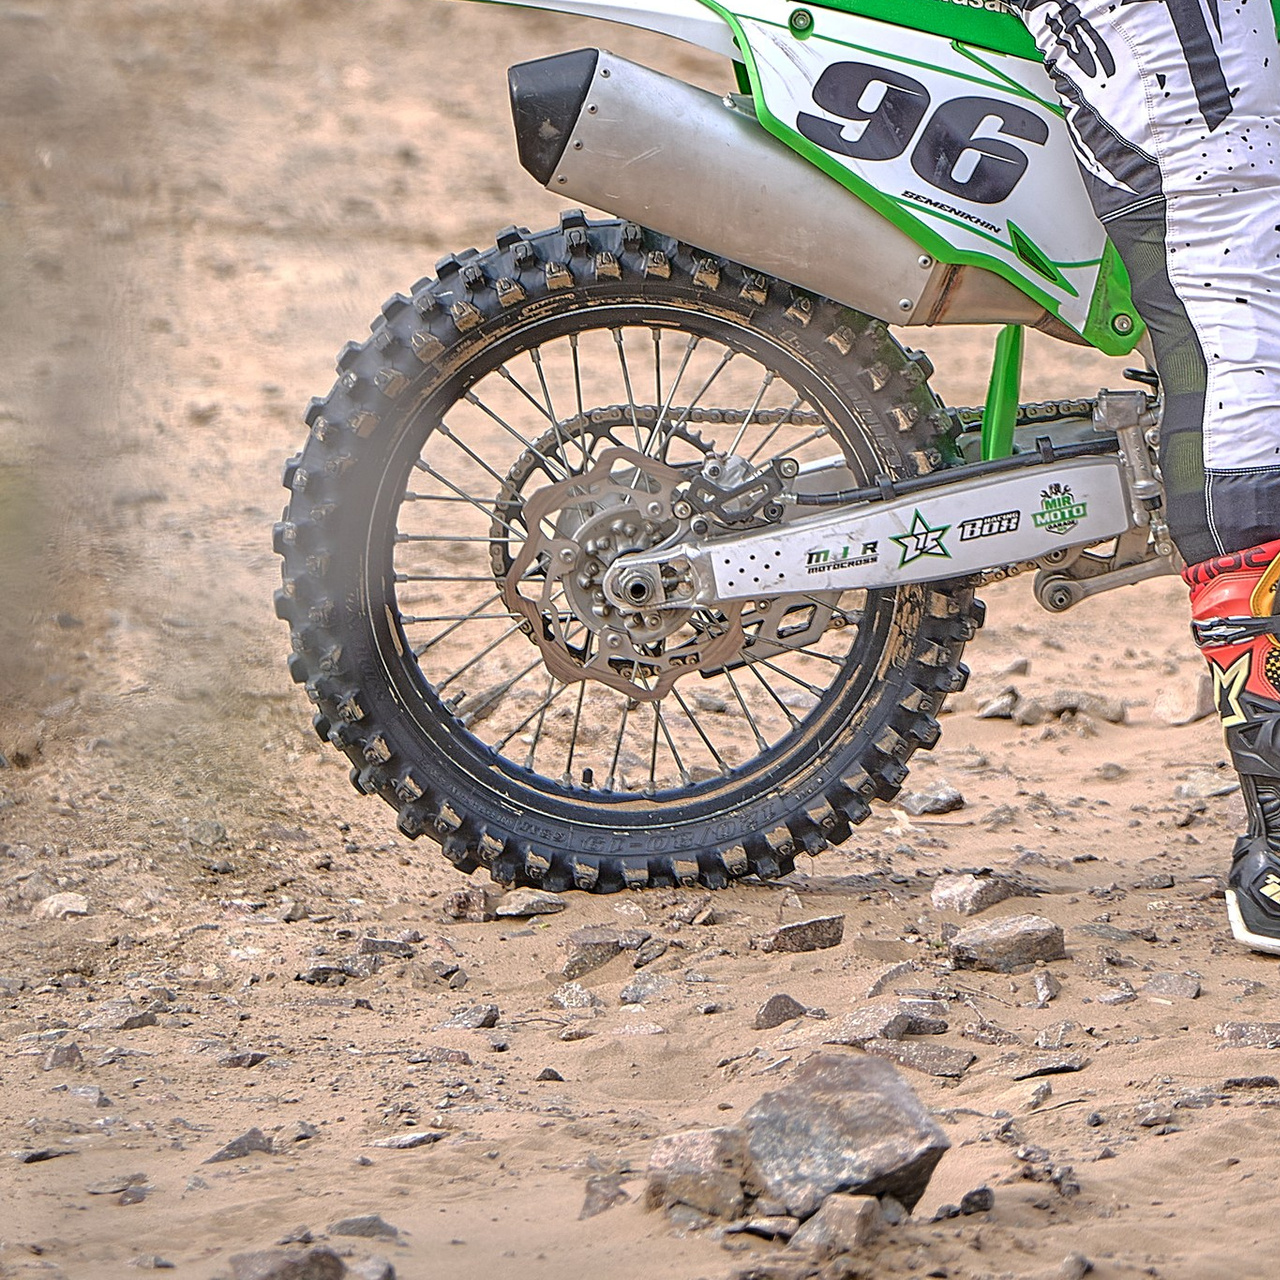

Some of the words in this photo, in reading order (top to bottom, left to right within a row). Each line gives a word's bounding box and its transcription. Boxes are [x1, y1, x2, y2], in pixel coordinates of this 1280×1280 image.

[796, 60, 1050, 205] 96
[901, 190, 1002, 234] SEMENIKHIN
[1044, 495, 1072, 510] MIR
[984, 511, 1019, 523] RACING
[1036, 505, 1084, 525] MOTO
[807, 556, 879, 575] MOTOCROSS
